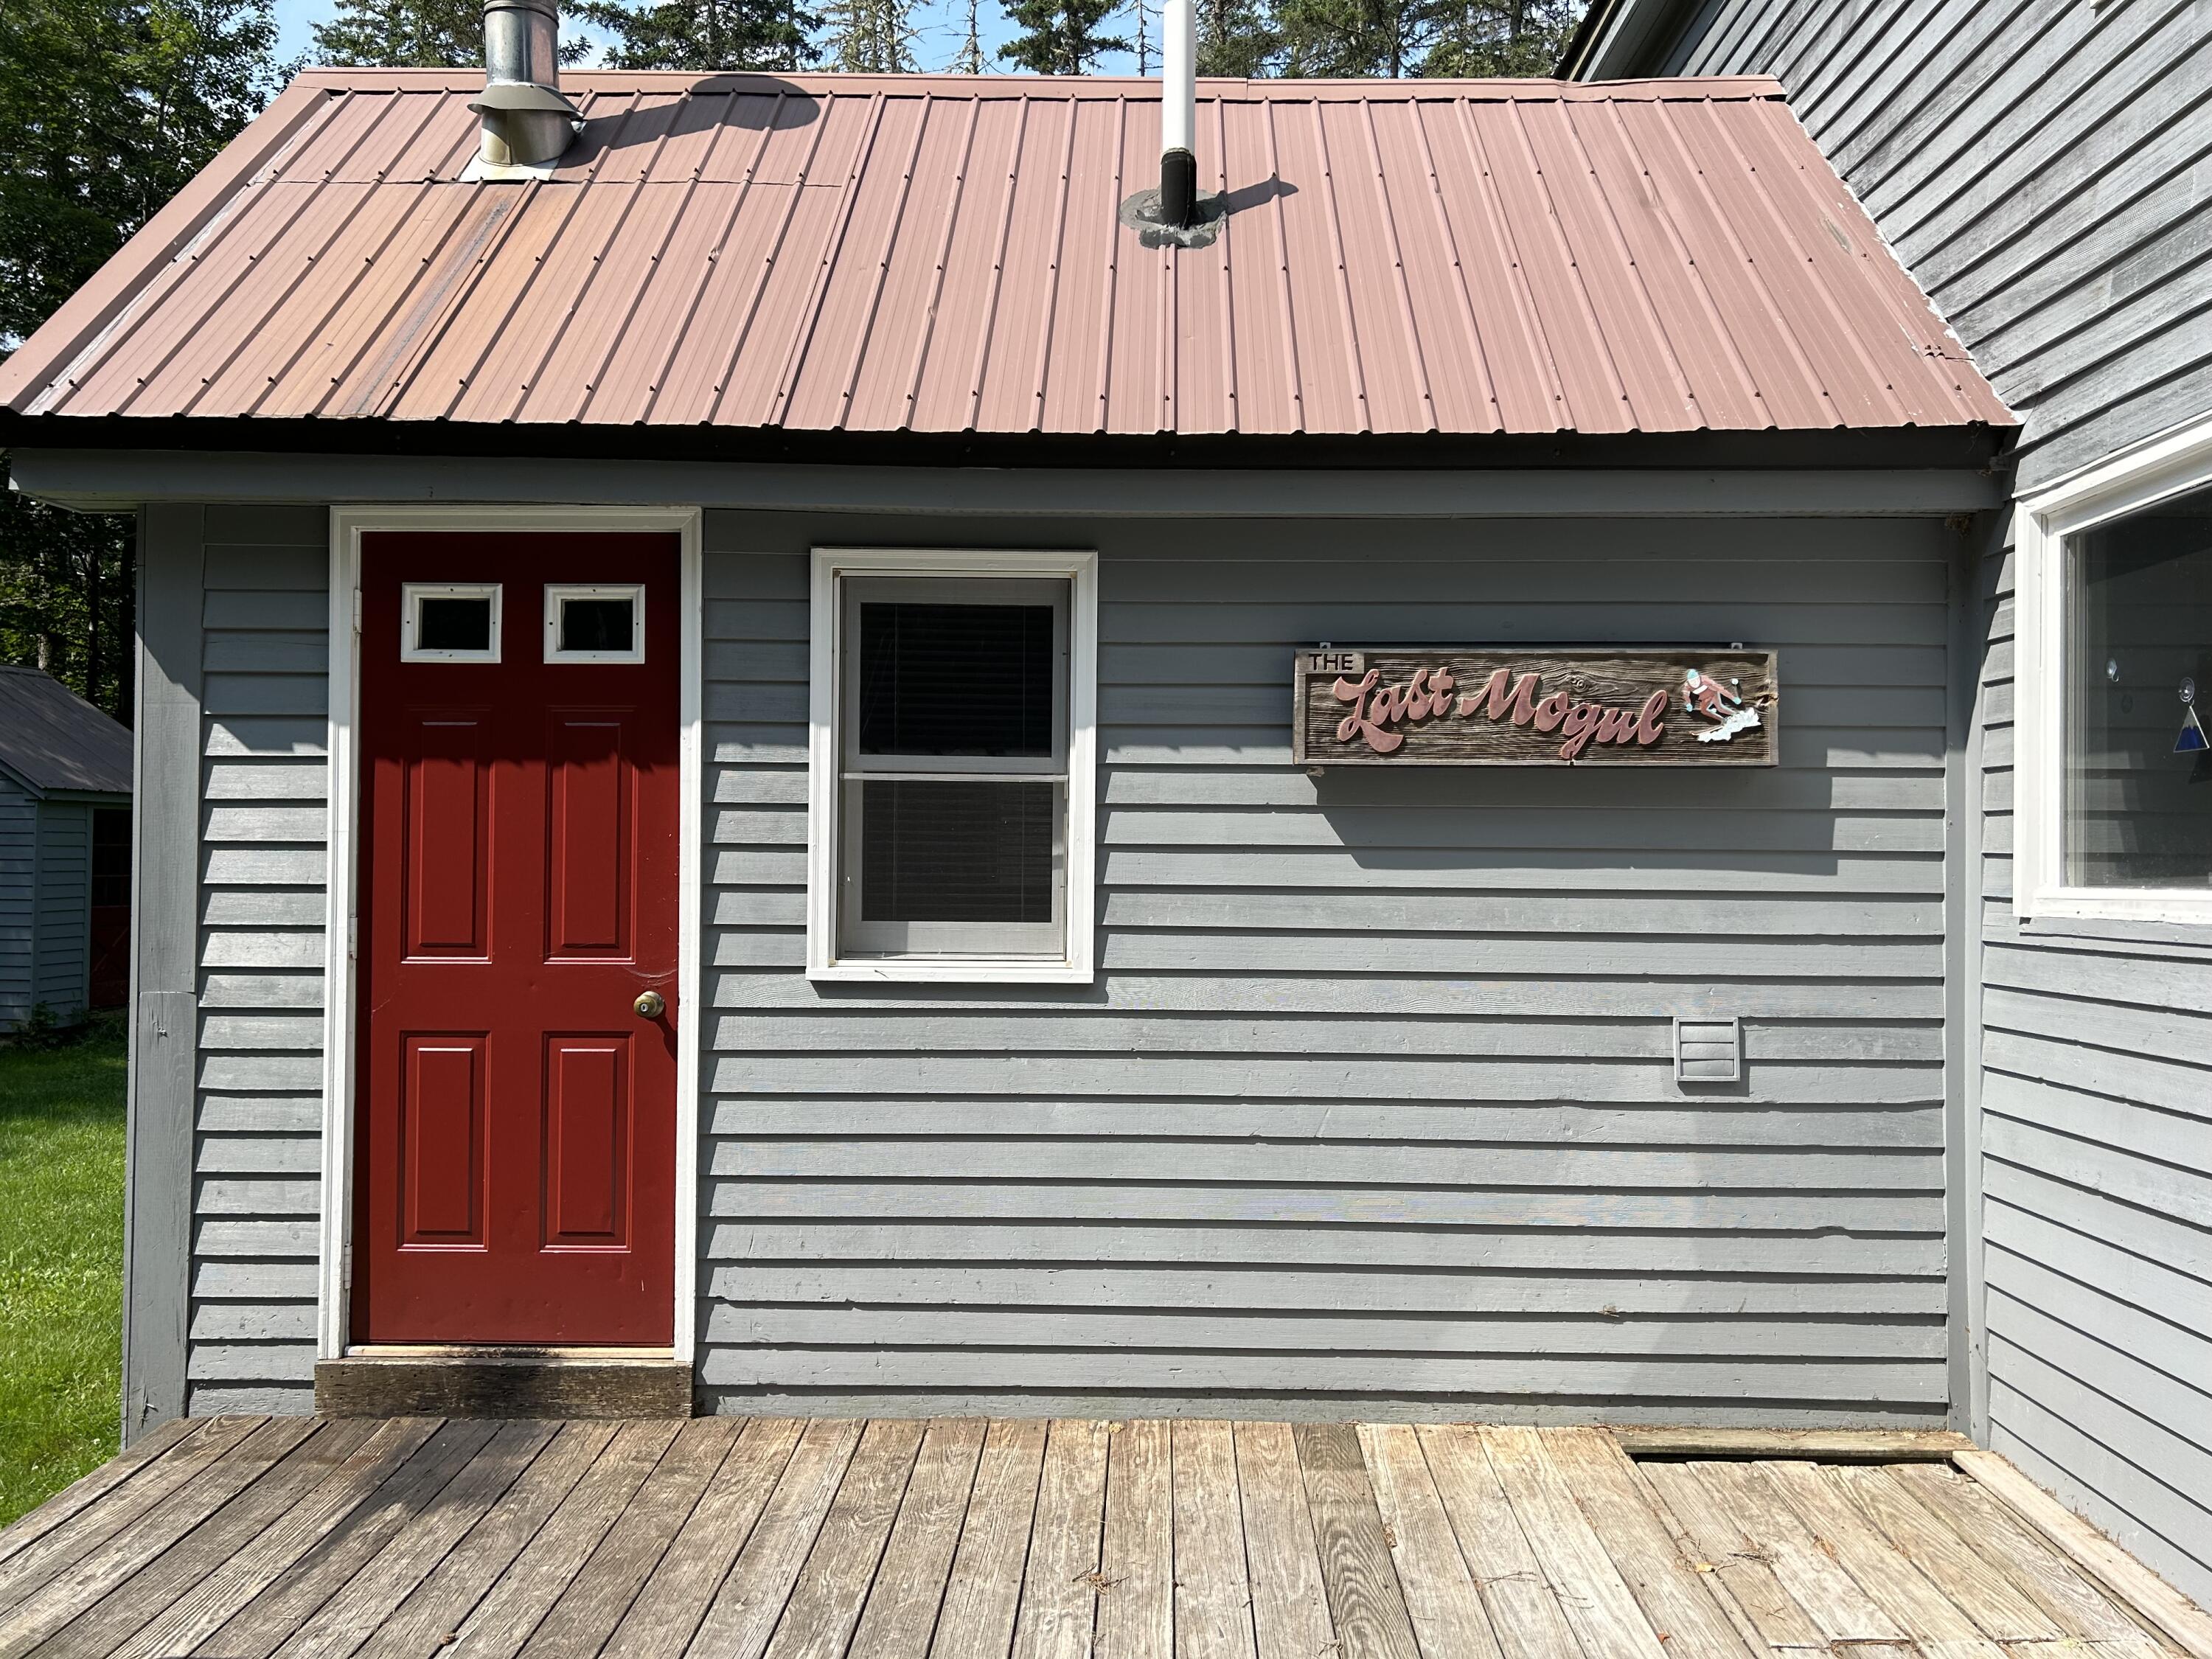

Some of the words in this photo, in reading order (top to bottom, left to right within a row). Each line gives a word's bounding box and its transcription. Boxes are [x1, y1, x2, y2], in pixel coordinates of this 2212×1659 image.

[1309, 653, 1354, 670] THE
[1333, 667, 1454, 753] Last
[1460, 669, 1667, 759] Mogul
